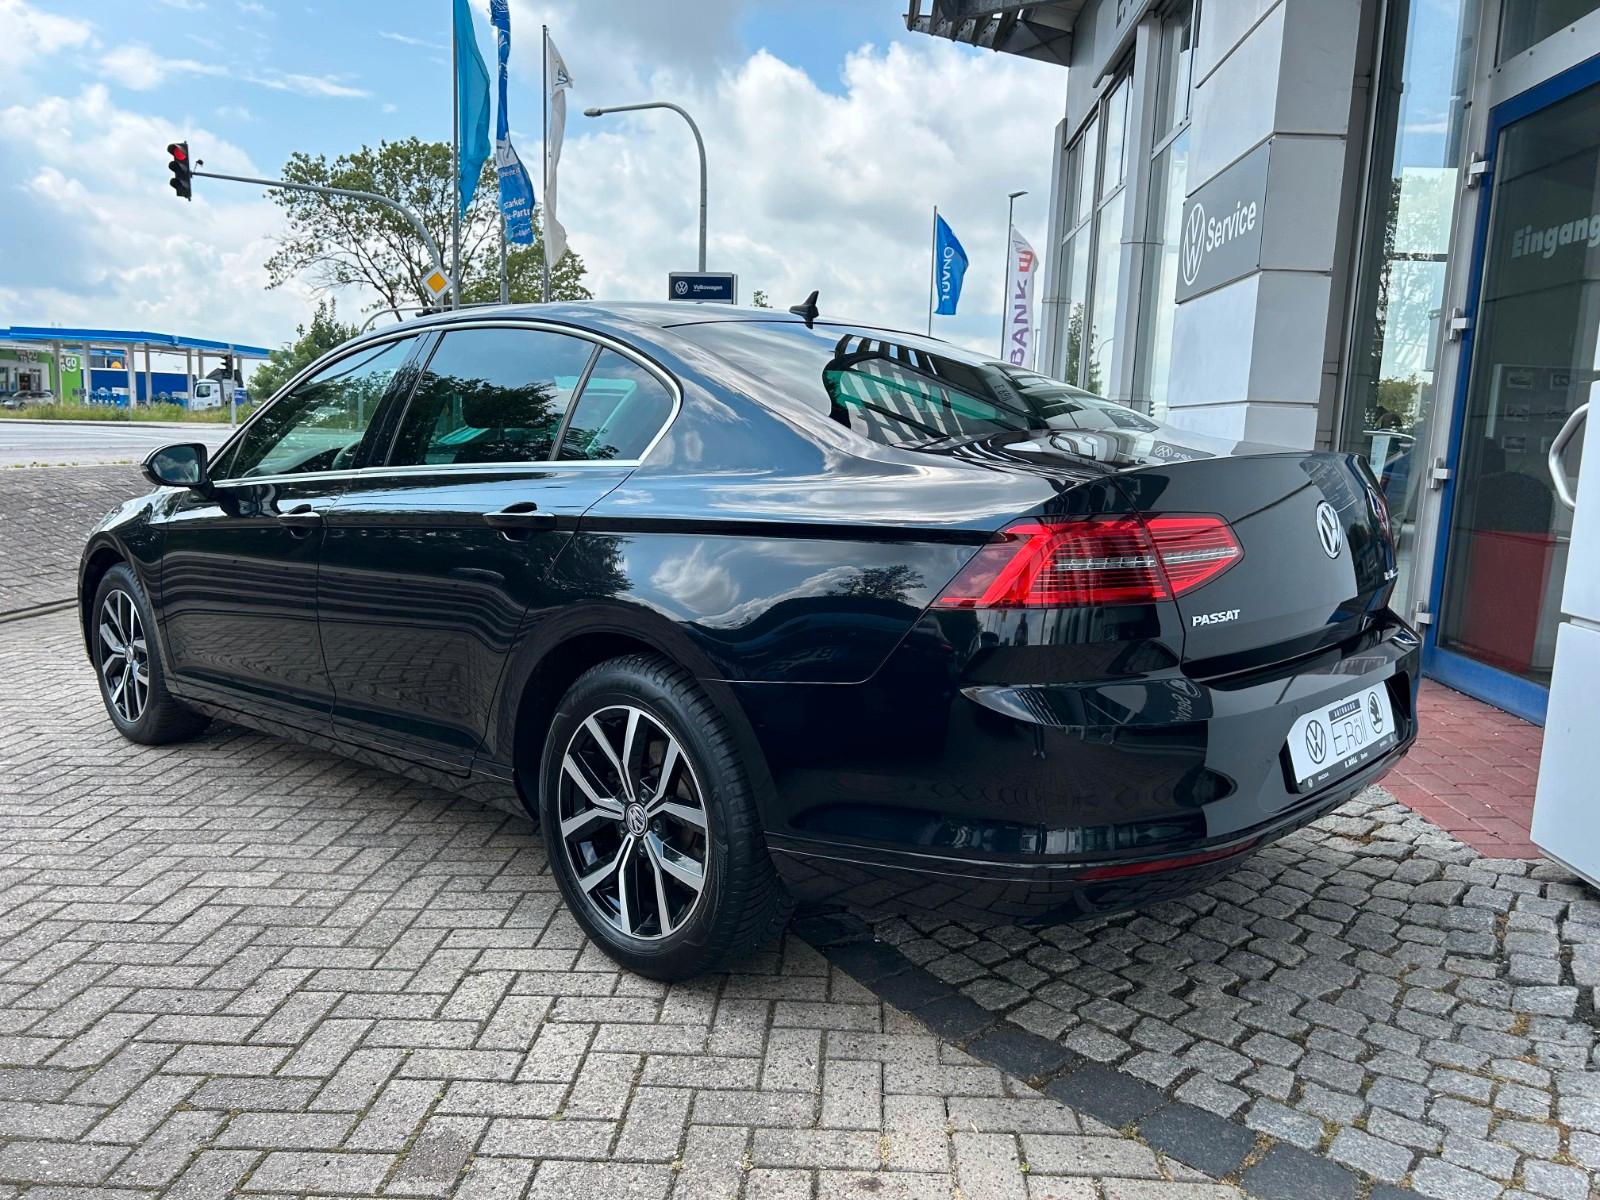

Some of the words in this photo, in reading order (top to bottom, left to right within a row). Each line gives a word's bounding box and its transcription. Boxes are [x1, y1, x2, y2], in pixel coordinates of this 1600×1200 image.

[1206, 201, 1257, 252] Service
[1511, 214, 1600, 259] Eingang
[1010, 279, 1029, 366] BANK
[1192, 609, 1241, 627] PASSAT
